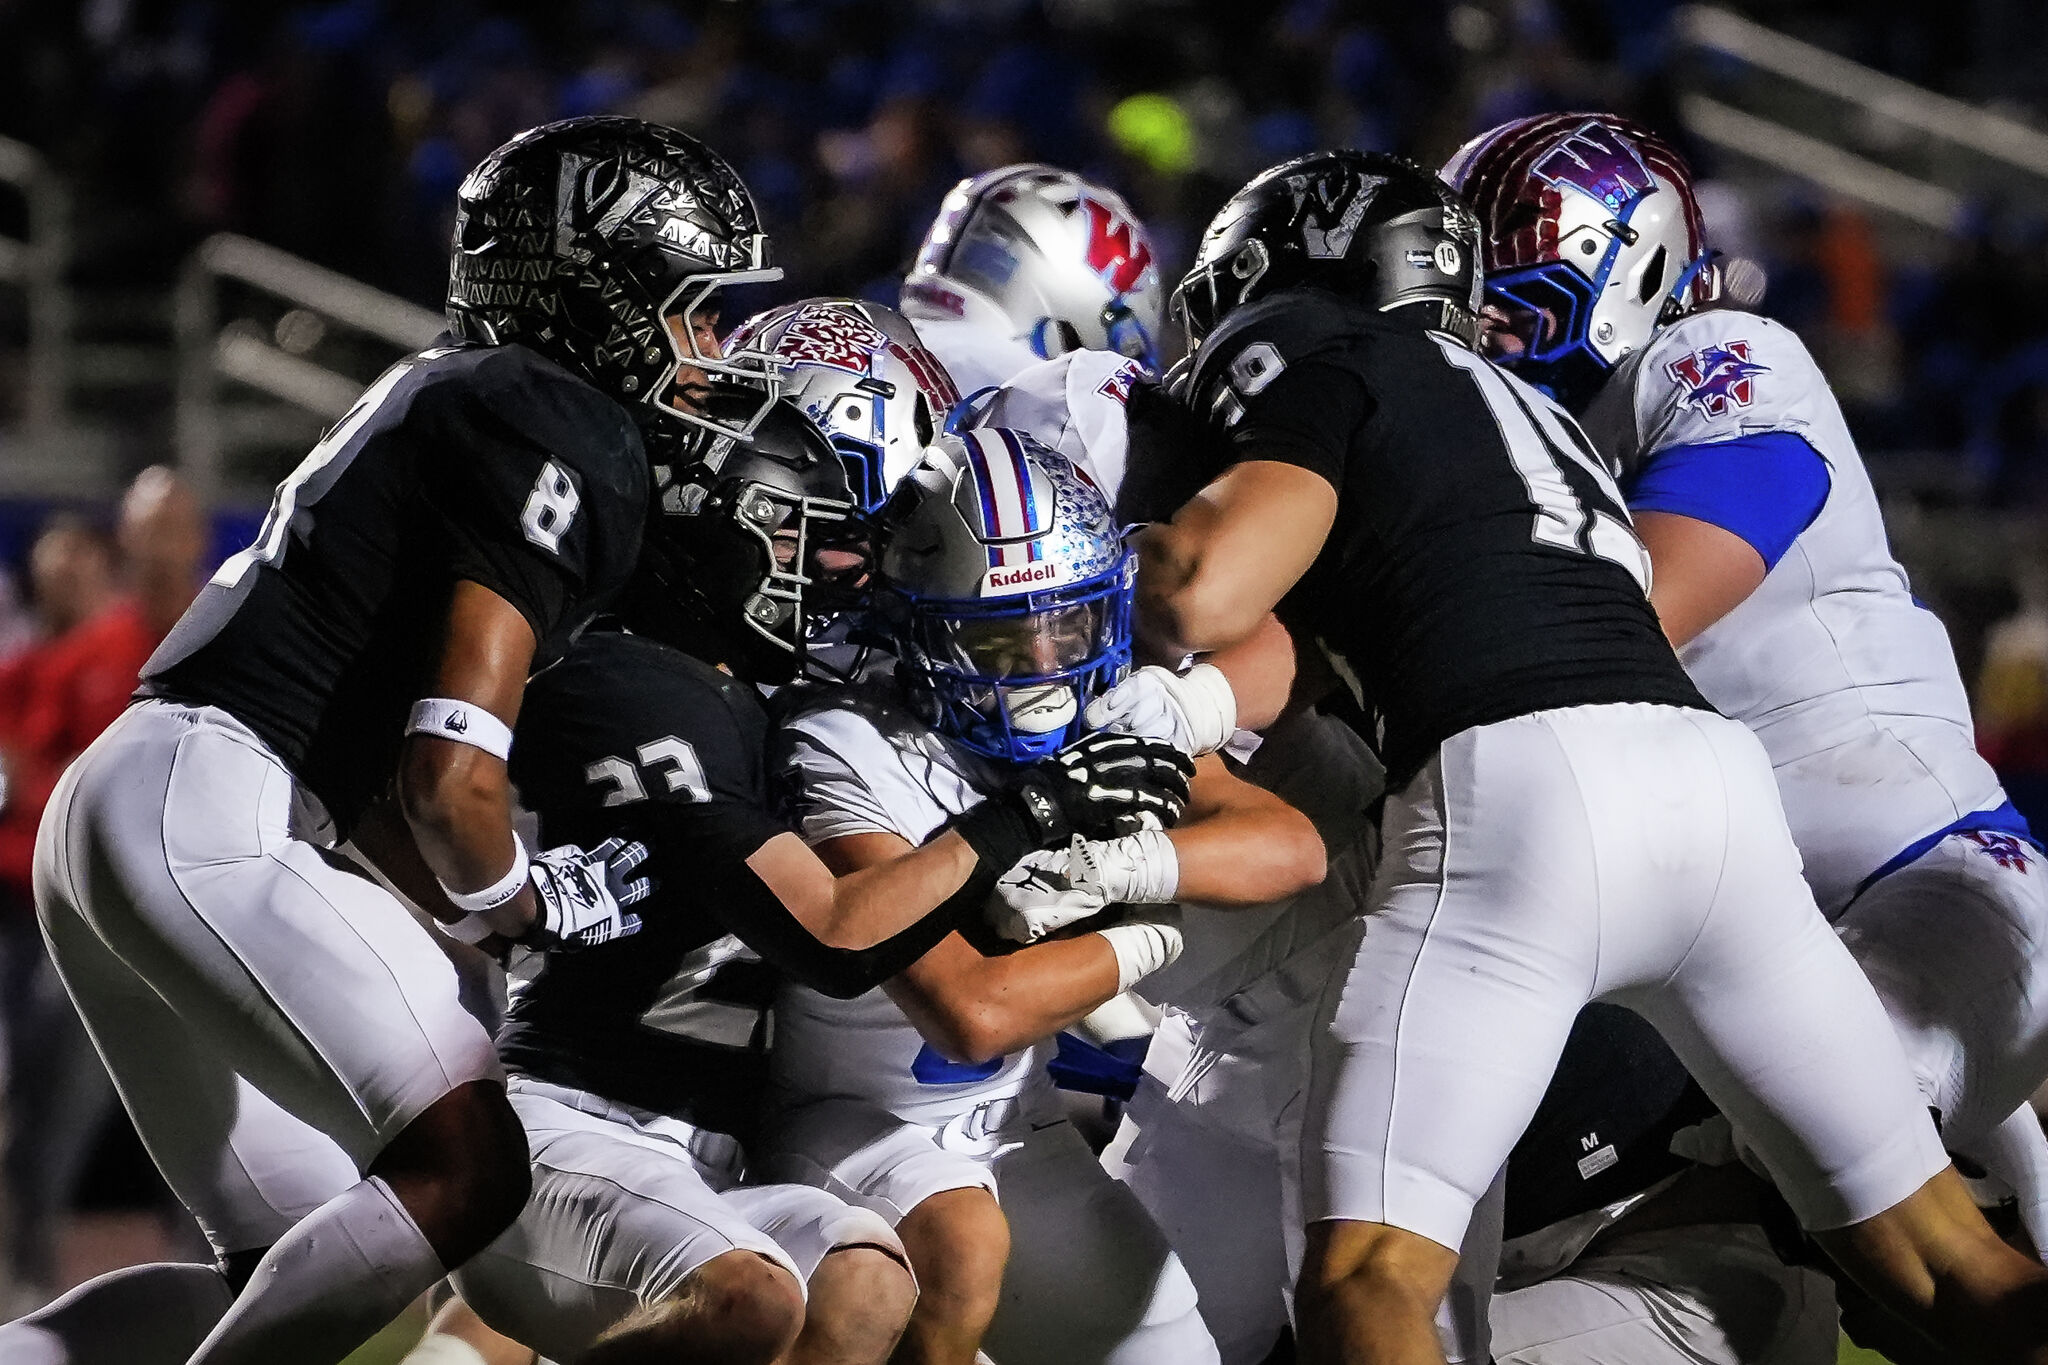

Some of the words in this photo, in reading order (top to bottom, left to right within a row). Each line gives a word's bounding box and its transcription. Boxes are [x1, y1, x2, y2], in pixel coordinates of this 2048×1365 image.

[1079, 195, 1153, 294] W
[520, 460, 581, 556] 8
[989, 564, 1056, 588] Riddell
[1580, 1131, 1600, 1152] M
